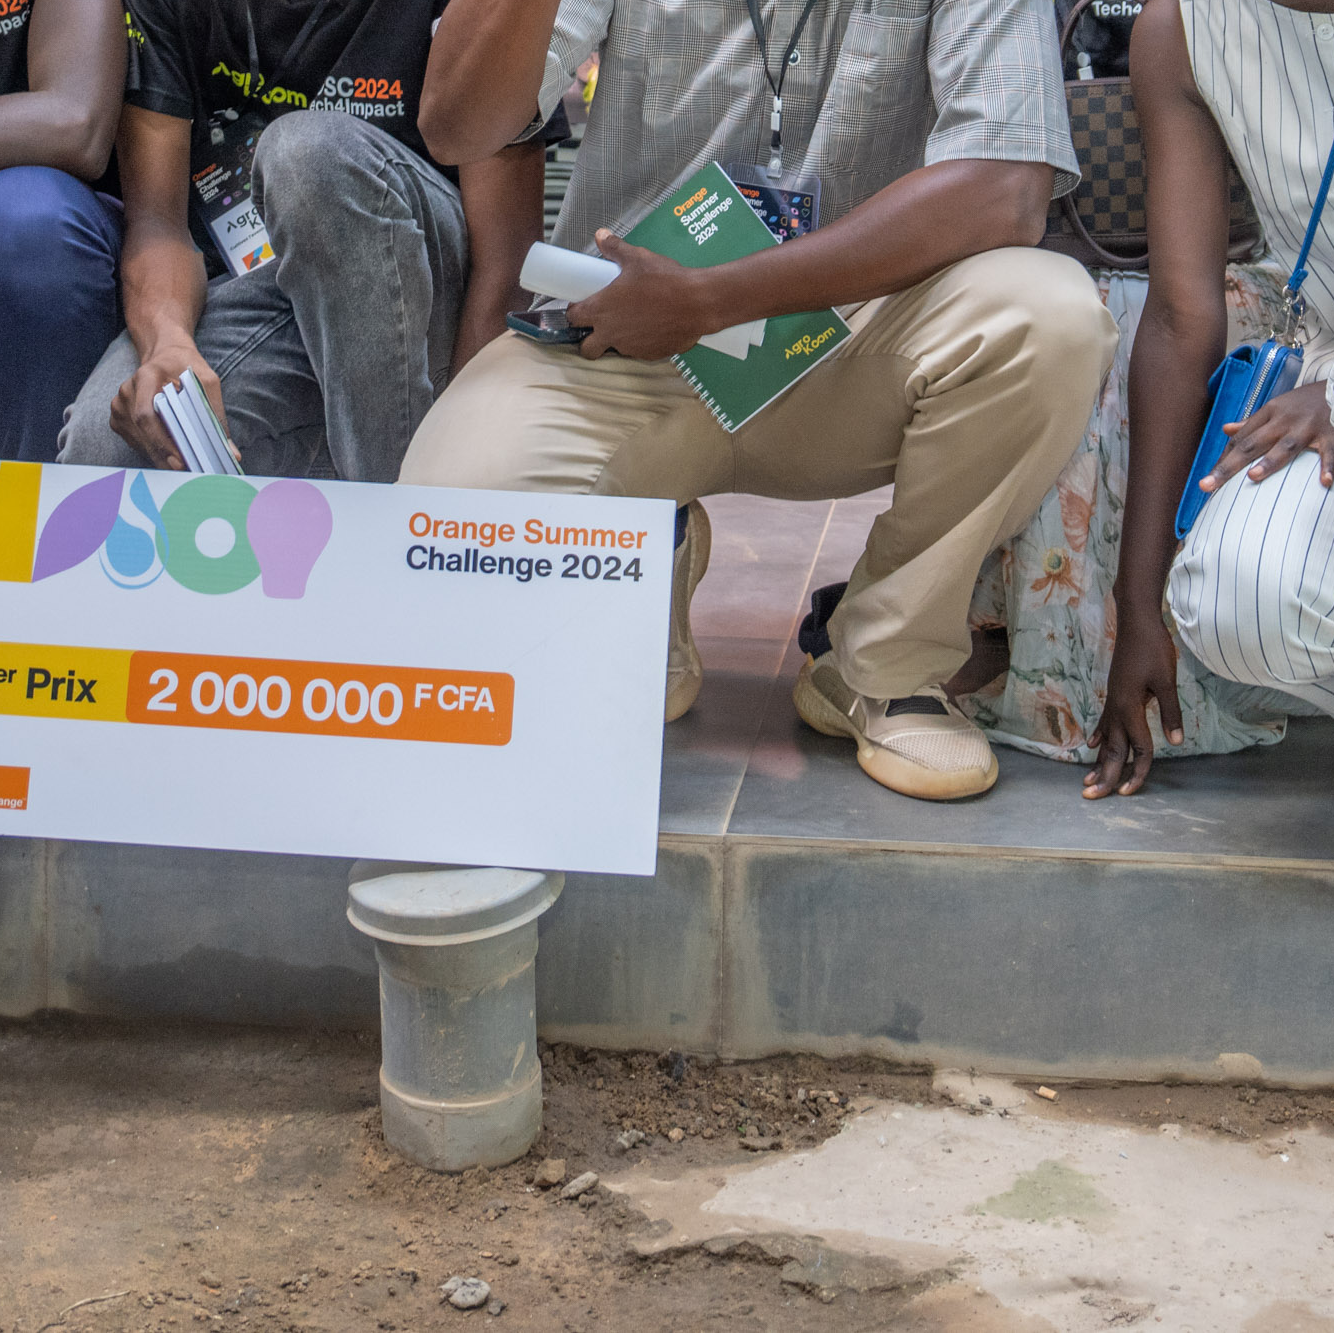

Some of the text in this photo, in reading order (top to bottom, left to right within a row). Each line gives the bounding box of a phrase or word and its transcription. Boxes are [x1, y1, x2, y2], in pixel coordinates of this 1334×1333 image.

[316, 75, 404, 100] SC2024
[309, 96, 405, 119] ech4Impact
[673, 187, 708, 217] Orange
[680, 191, 720, 226] Summer
[688, 196, 734, 235] Challenge
[694, 222, 719, 246] 2024
[785, 335, 811, 360] Agro
[802, 326, 836, 356] Koom
[409, 512, 648, 549] Orange Summer
[406, 544, 644, 583] Challenge 2024
[25, 667, 98, 704] Prix
[147, 668, 178, 712] 2
[190, 670, 293, 723] 000
[302, 678, 405, 727] 000
